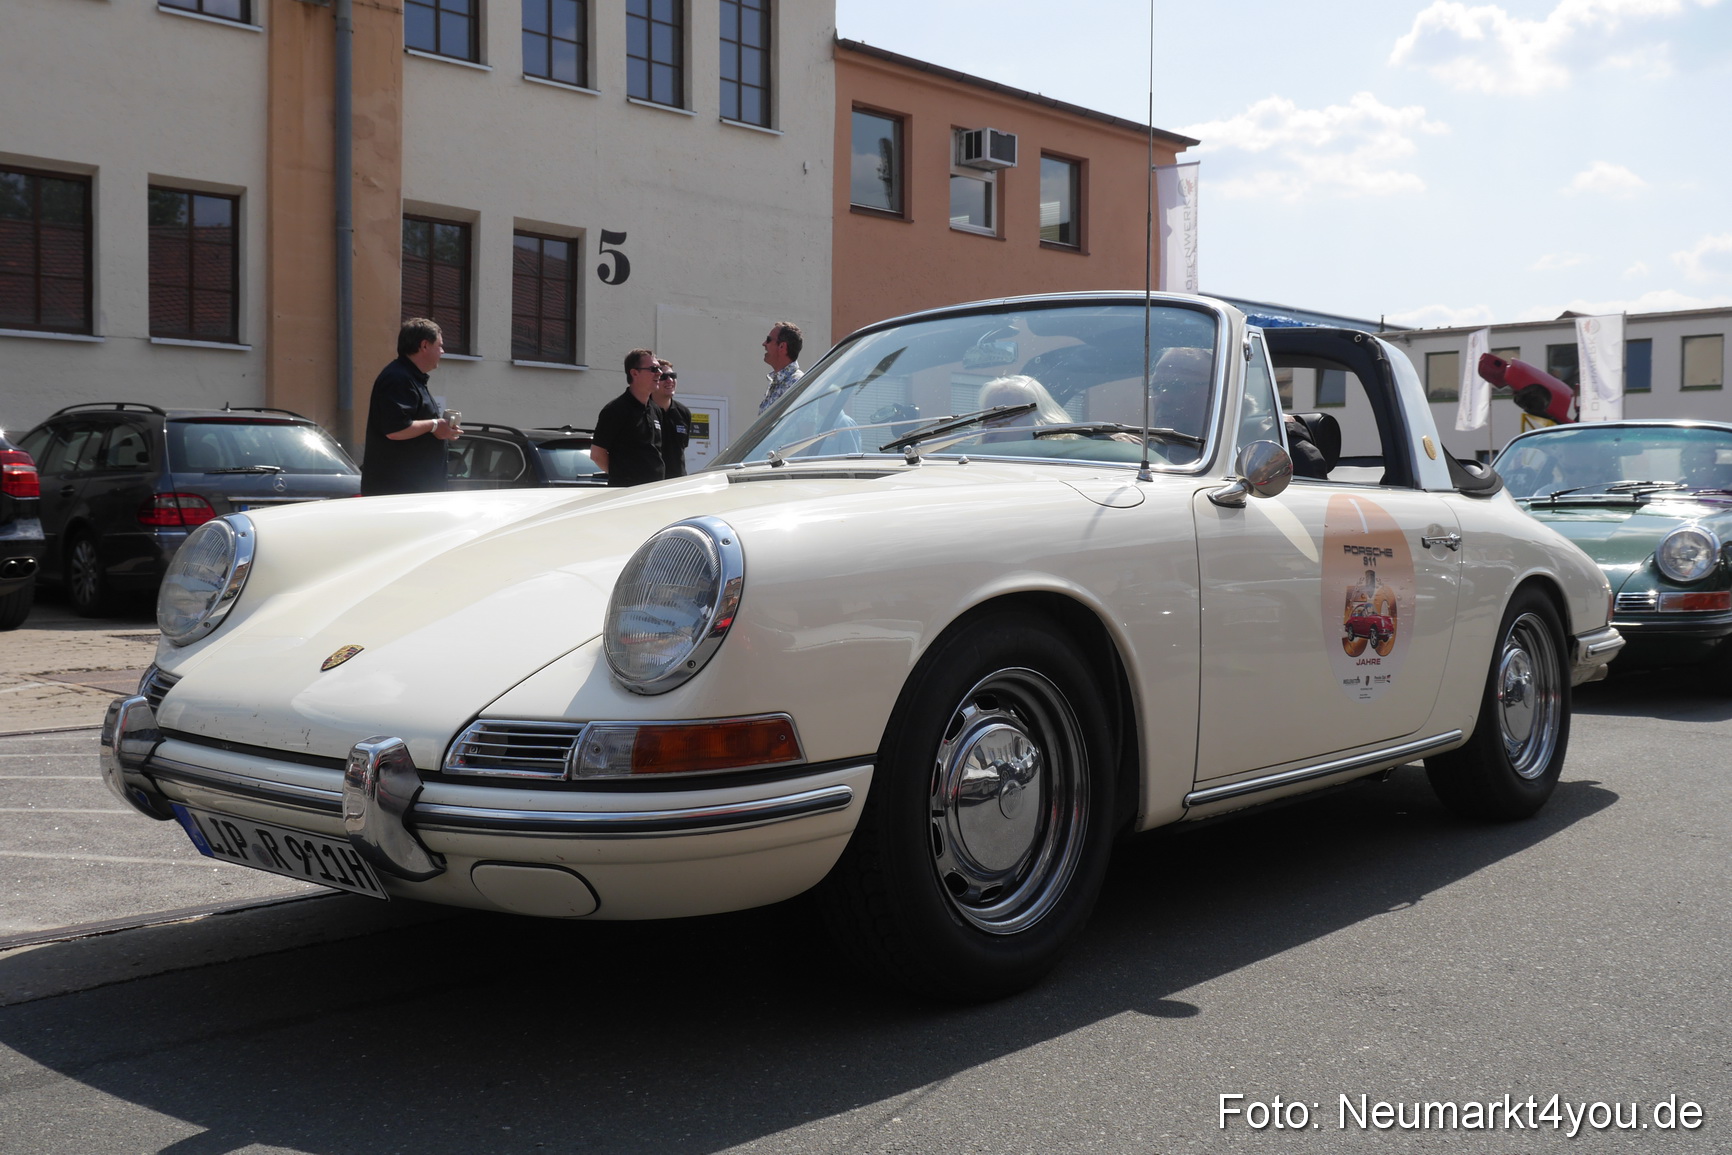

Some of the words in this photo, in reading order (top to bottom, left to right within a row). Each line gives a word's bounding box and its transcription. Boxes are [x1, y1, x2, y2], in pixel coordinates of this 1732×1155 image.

[597, 228, 631, 286] 5
[1343, 544, 1393, 558] PORSCHE
[1363, 556, 1377, 567] 911
[1355, 658, 1381, 666] JAHRE
[190, 812, 248, 860] LIP
[255, 828, 292, 871] R
[284, 834, 378, 892] 911H
